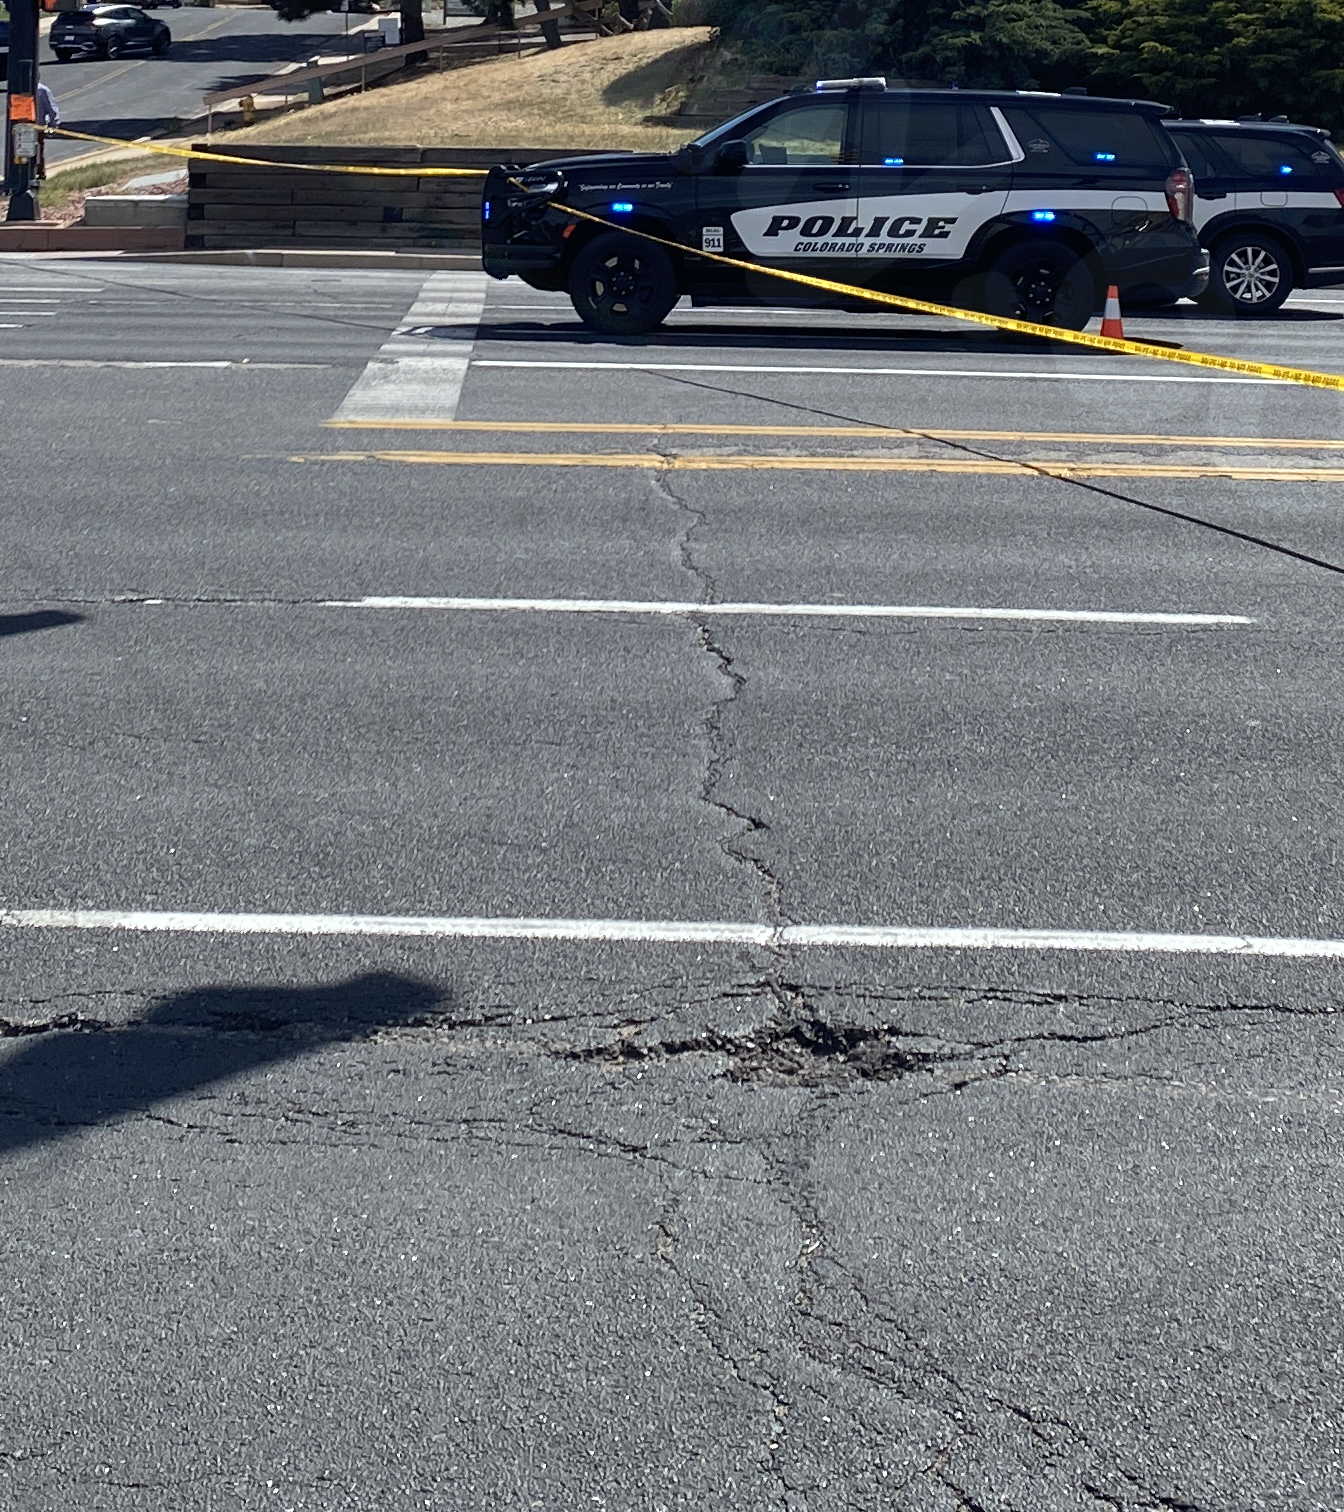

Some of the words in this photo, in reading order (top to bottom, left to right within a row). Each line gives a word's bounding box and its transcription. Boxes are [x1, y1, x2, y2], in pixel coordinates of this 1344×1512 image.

[763, 215, 959, 239] POLICE
[704, 237, 722, 248] 911
[793, 241, 862, 253] COLORADO
[866, 242, 927, 254] SPRINGS
